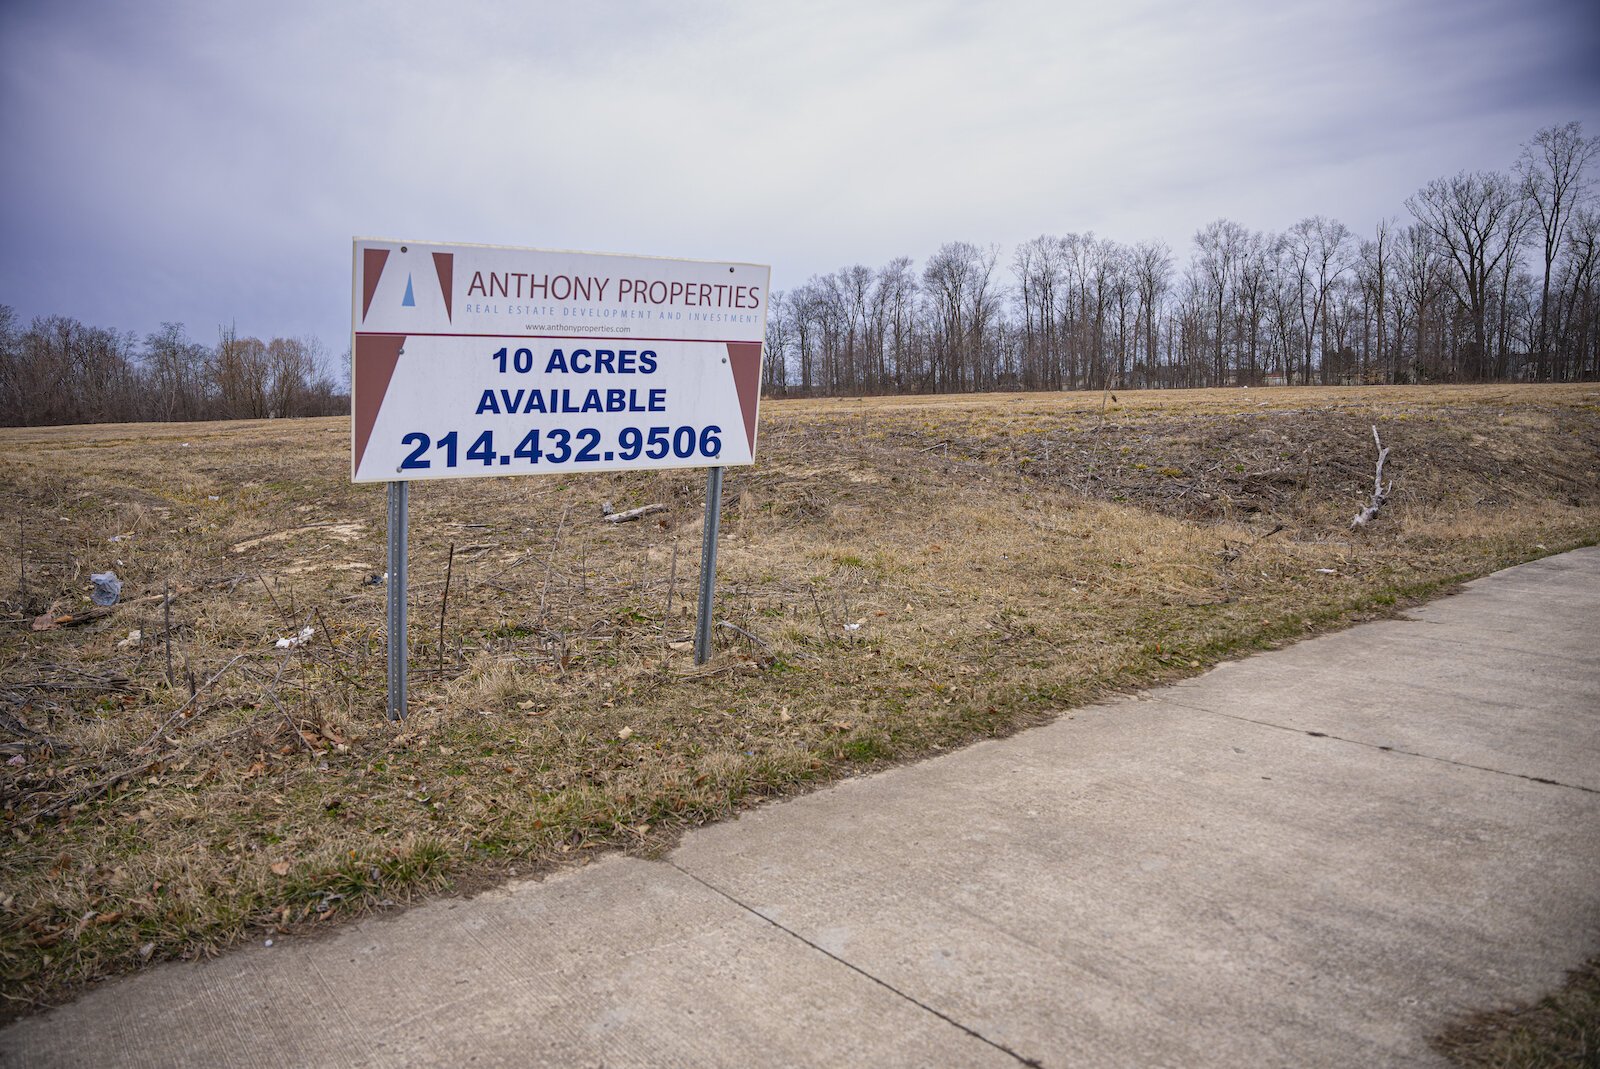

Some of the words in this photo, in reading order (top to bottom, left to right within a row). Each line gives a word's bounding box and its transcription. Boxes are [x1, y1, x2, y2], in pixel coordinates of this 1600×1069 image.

[467, 271, 610, 302] ANTHONY
[618, 279, 760, 309] PROPERTIES
[466, 304, 498, 314] REAL
[508, 305, 555, 316] ESTATE
[563, 307, 652, 319] DEVELOPMENT
[659, 311, 681, 321] AND
[689, 312, 759, 323] INVESTMENT
[525, 323, 631, 334] www.anthonyproperties.com
[492, 347, 533, 374] 10
[545, 349, 658, 374] ACRES
[475, 388, 667, 415] AVAILABLE
[400, 425, 723, 470] 214.432.9506
